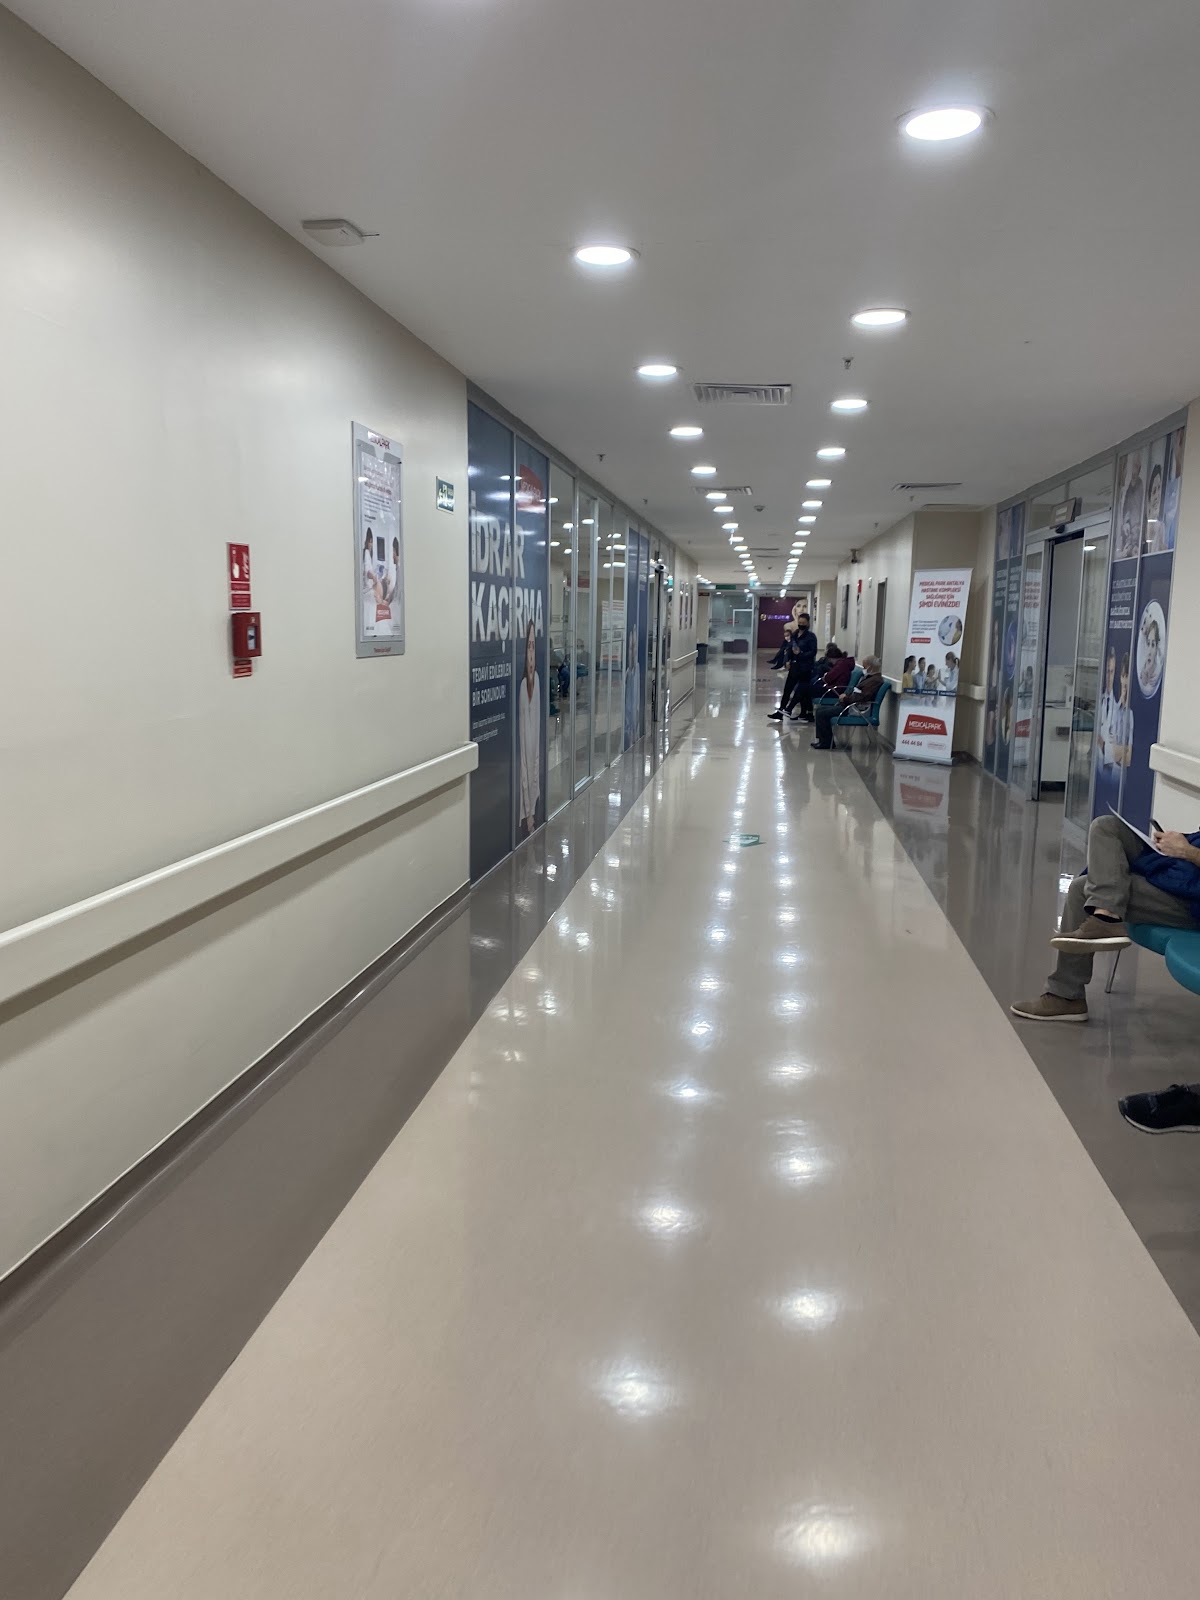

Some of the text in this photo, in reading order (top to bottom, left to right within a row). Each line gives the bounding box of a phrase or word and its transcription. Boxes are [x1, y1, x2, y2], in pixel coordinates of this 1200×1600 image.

[471, 490, 525, 579] İDRAR
[919, 600, 933, 609] ŞİMDİ
[471, 581, 544, 654] KAÇIRMA
[472, 660, 512, 683] TEDAVİ EDİLEBİLEN
[472, 687, 481, 707] BİR
[908, 720, 942, 731] MEDICALPARK
